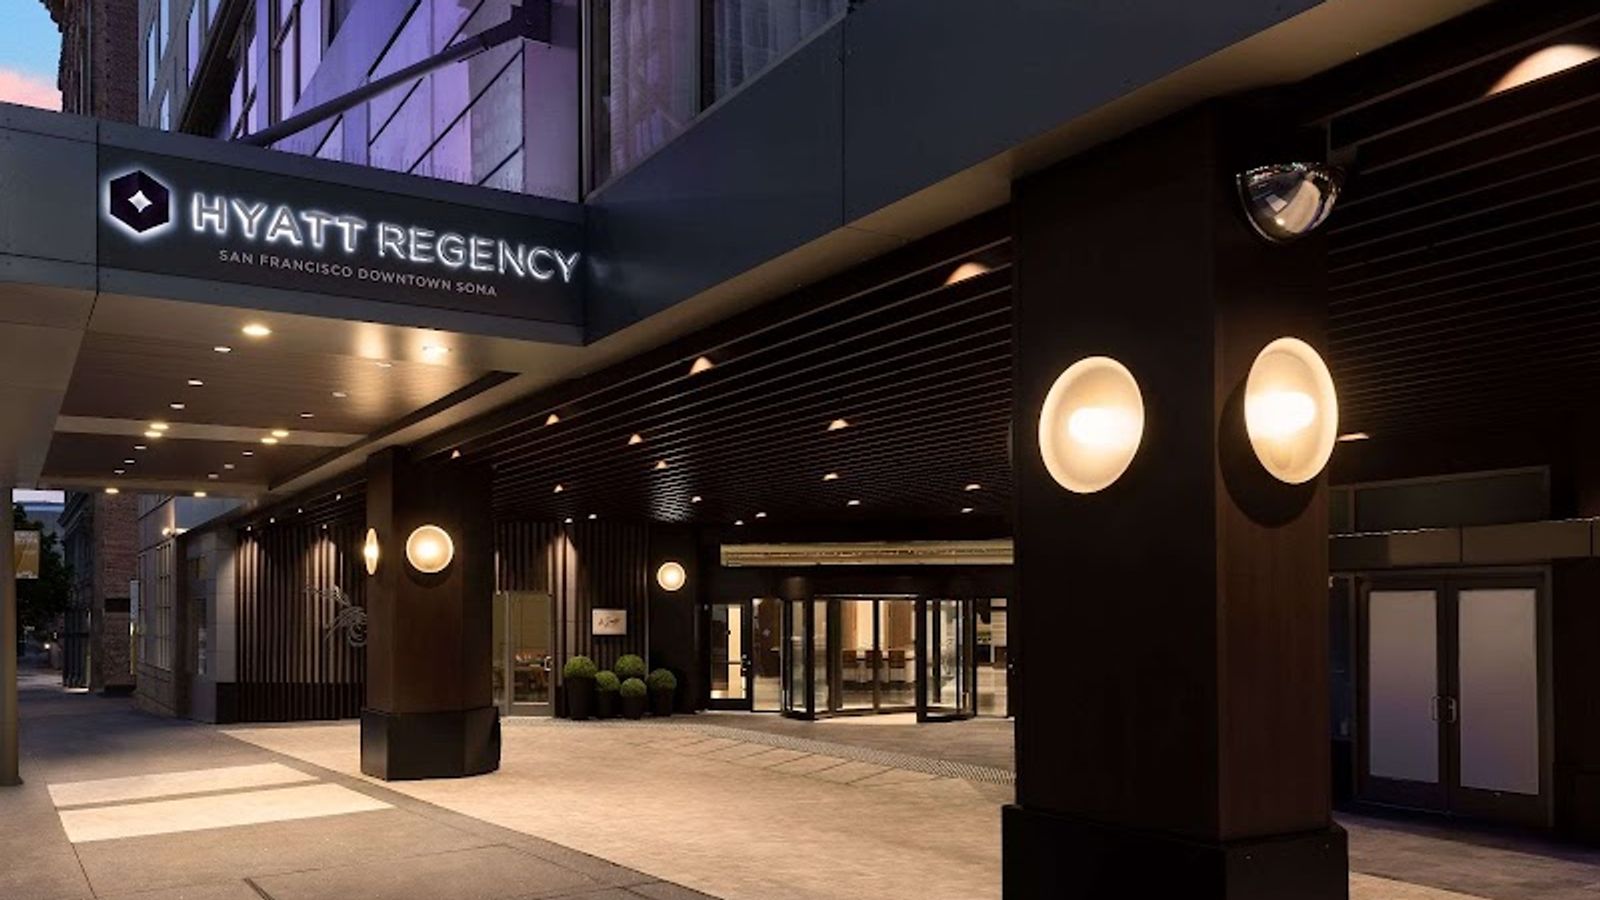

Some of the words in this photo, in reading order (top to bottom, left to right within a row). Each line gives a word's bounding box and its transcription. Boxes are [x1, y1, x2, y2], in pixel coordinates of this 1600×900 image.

[191, 192, 367, 254] HYATT
[376, 221, 580, 283] REGENCY
[219, 249, 254, 266] SAN
[260, 254, 354, 279] FRANCISCO
[357, 267, 452, 291] DOWNTOWN
[456, 280, 498, 297] SOMA
